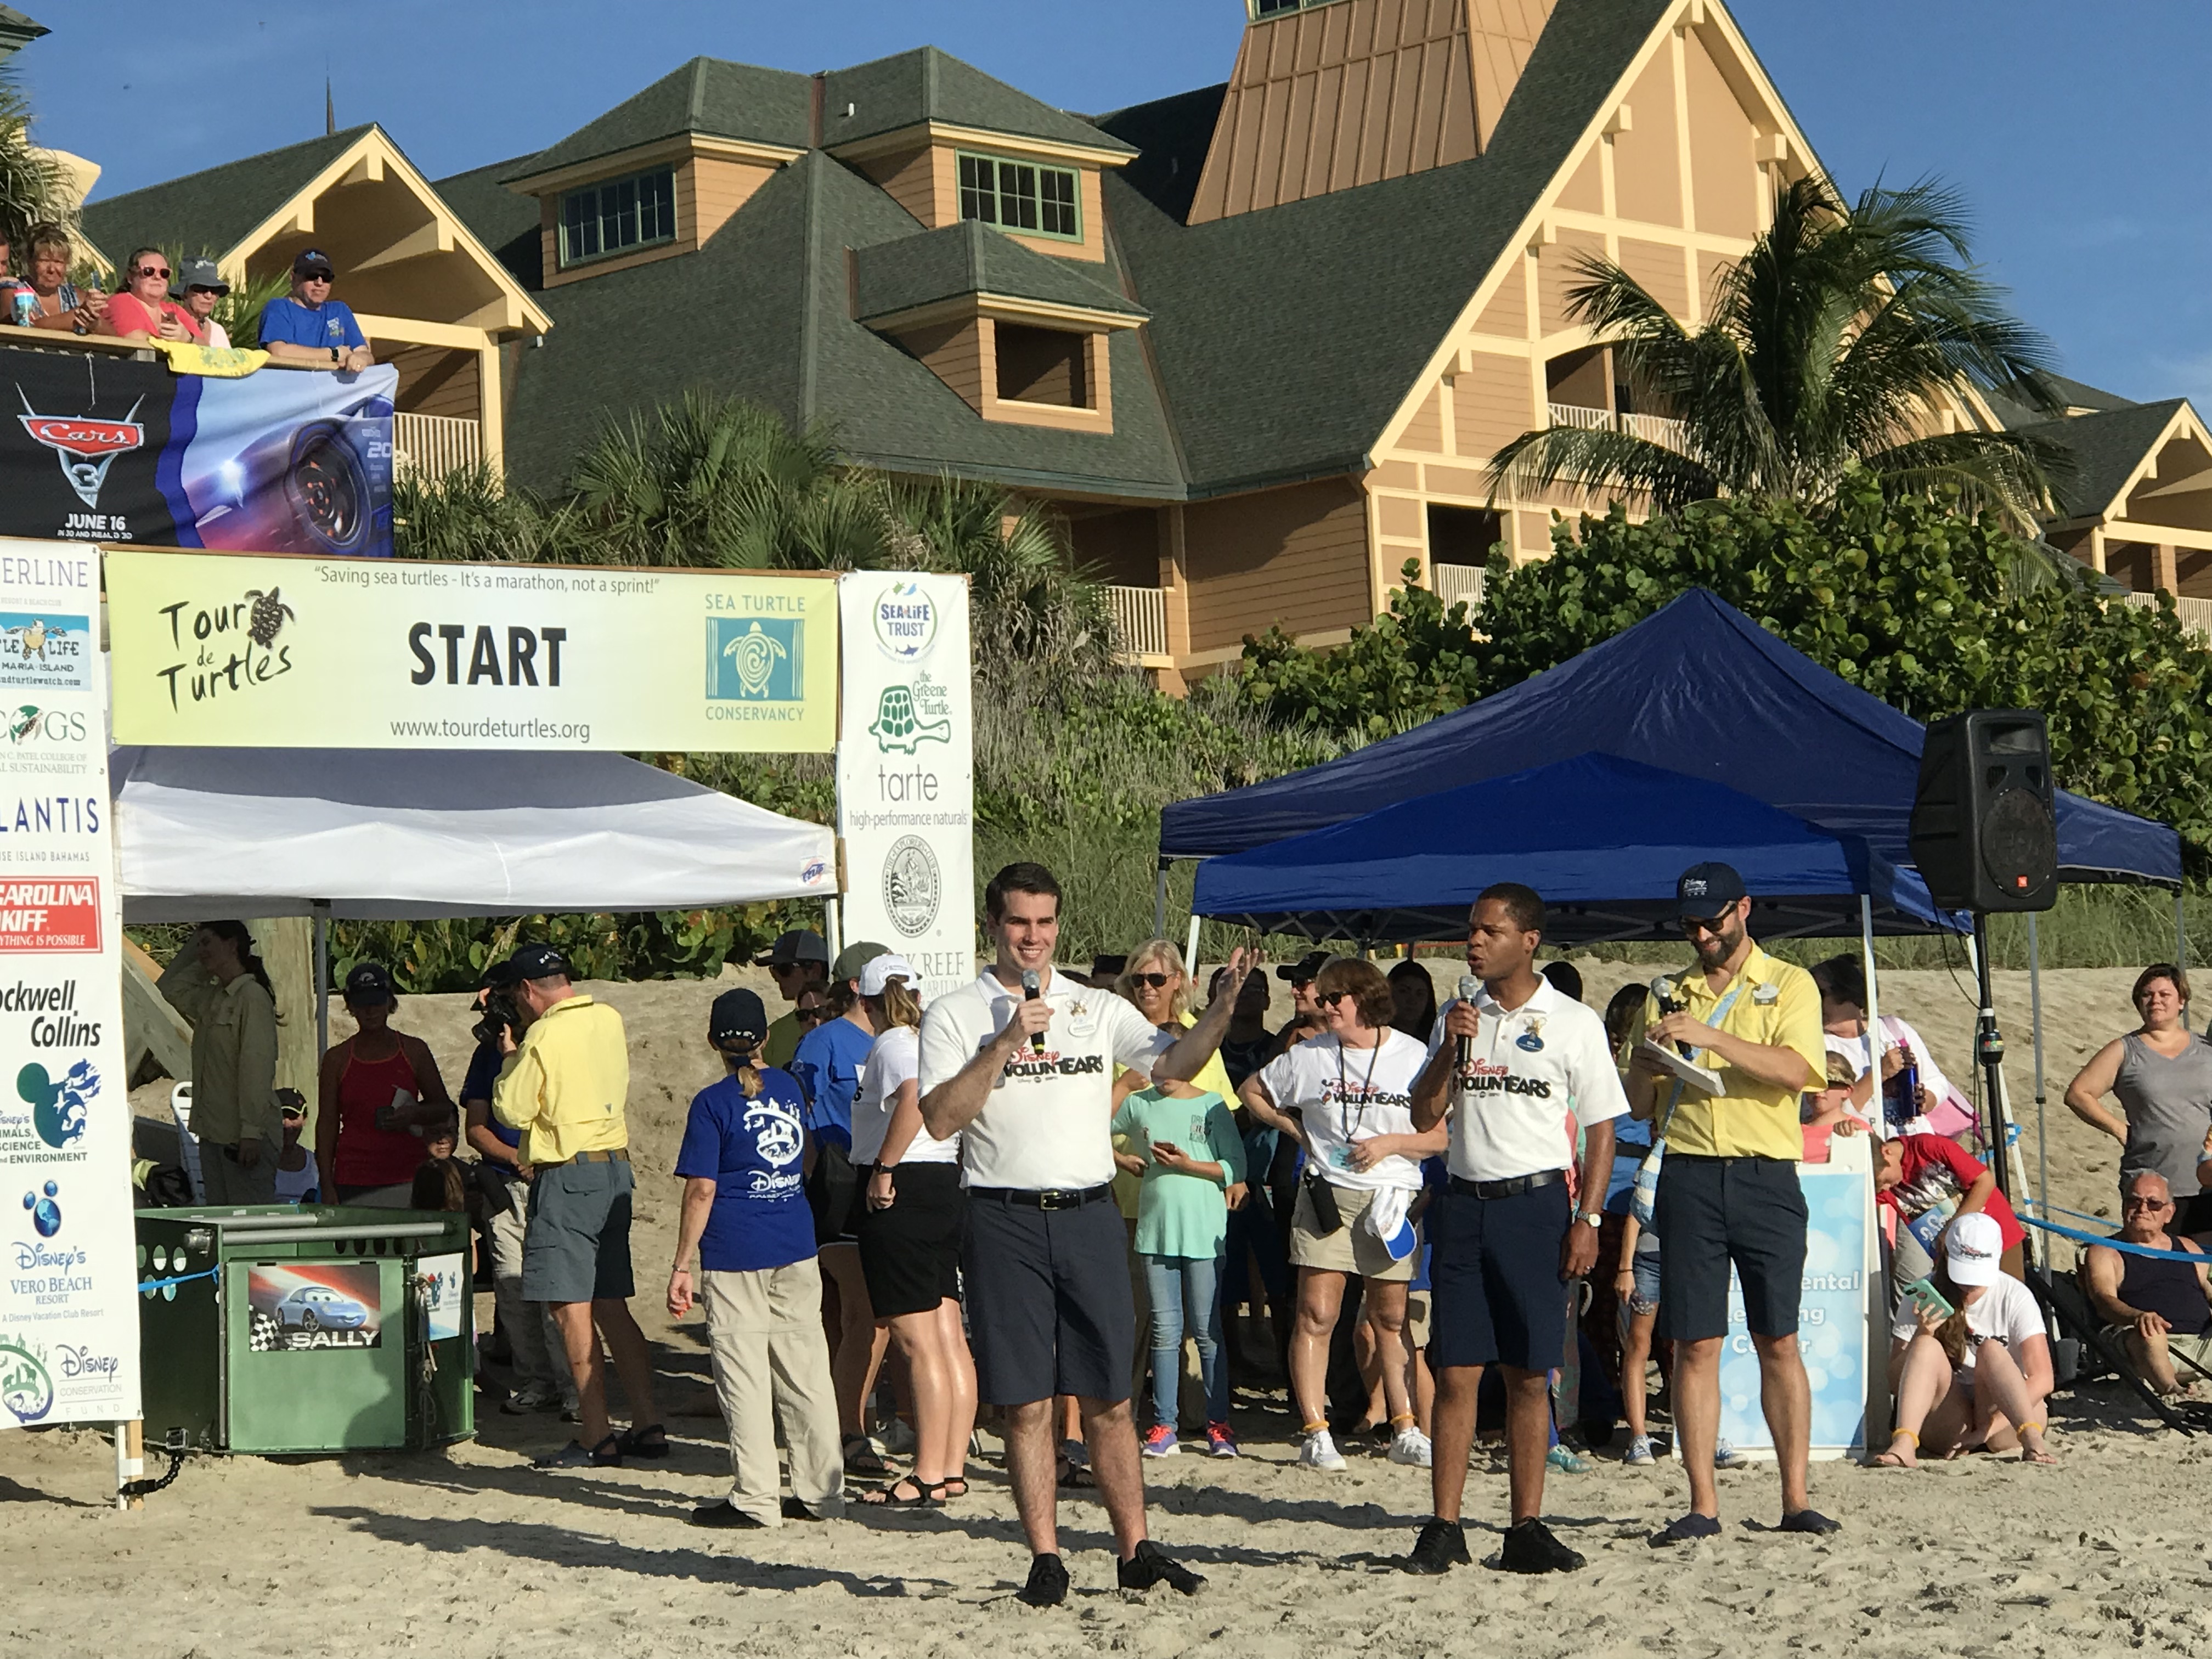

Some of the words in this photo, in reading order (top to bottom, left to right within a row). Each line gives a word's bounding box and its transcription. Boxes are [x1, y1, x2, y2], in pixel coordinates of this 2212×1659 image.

[40, 422, 130, 444] Cars
[71, 463, 99, 494] 3
[65, 513, 107, 529] JUNE
[110, 516, 126, 531] 16
[2, 557, 88, 587] ERLINE
[374, 572, 397, 584] sea
[402, 569, 448, 586] turtles
[484, 576, 492, 588] a
[496, 573, 567, 592] marathon,
[572, 578, 595, 591] not
[599, 580, 607, 592] a
[705, 594, 736, 610] SEA
[742, 595, 805, 612] TURTLE
[159, 601, 246, 651] Tour
[887, 622, 924, 636] TRUST
[0, 639, 19, 653] LE
[48, 641, 79, 656] LIFE
[197, 645, 215, 667] de
[408, 622, 567, 687] START
[2, 662, 34, 670] MARIA
[40, 664, 74, 672] ISLAND
[0, 675, 81, 686] ndturtlewatch.com
[156, 641, 291, 713] Turtles
[920, 670, 932, 682] the
[912, 681, 947, 702] Greene
[706, 706, 804, 721] CONSERVANCY
[920, 698, 950, 715] Turtle
[390, 718, 590, 743] www.tourdeturtles.org
[17, 752, 39, 760] PATEL
[40, 752, 75, 761] COLLEGE
[9, 763, 87, 774] SUSTAINABILITY
[878, 764, 938, 801] tarte
[850, 809, 932, 830] high-performance
[934, 809, 967, 825] naturals
[16, 851, 46, 861] ISLAND
[50, 851, 89, 861] BAHAMAS
[36, 934, 44, 946] IS
[46, 934, 86, 946] POSSIBLE
[921, 952, 964, 977] REEF
[31, 1011, 101, 1047] Collins
[0, 1141, 41, 1151] CIENCE
[10, 1152, 88, 1164] ENVIRONMENT
[10, 1279, 46, 1294] VERO
[49, 1277, 92, 1291] BEACH
[36, 1294, 69, 1305] RESORT
[9, 1313, 31, 1322] Disney
[33, 1312, 61, 1321] Vacation
[63, 1310, 79, 1318] Club
[81, 1308, 104, 1317] Resort
[291, 1330, 380, 1347] SALLY
[60, 1384, 122, 1397] CONSERVATION
